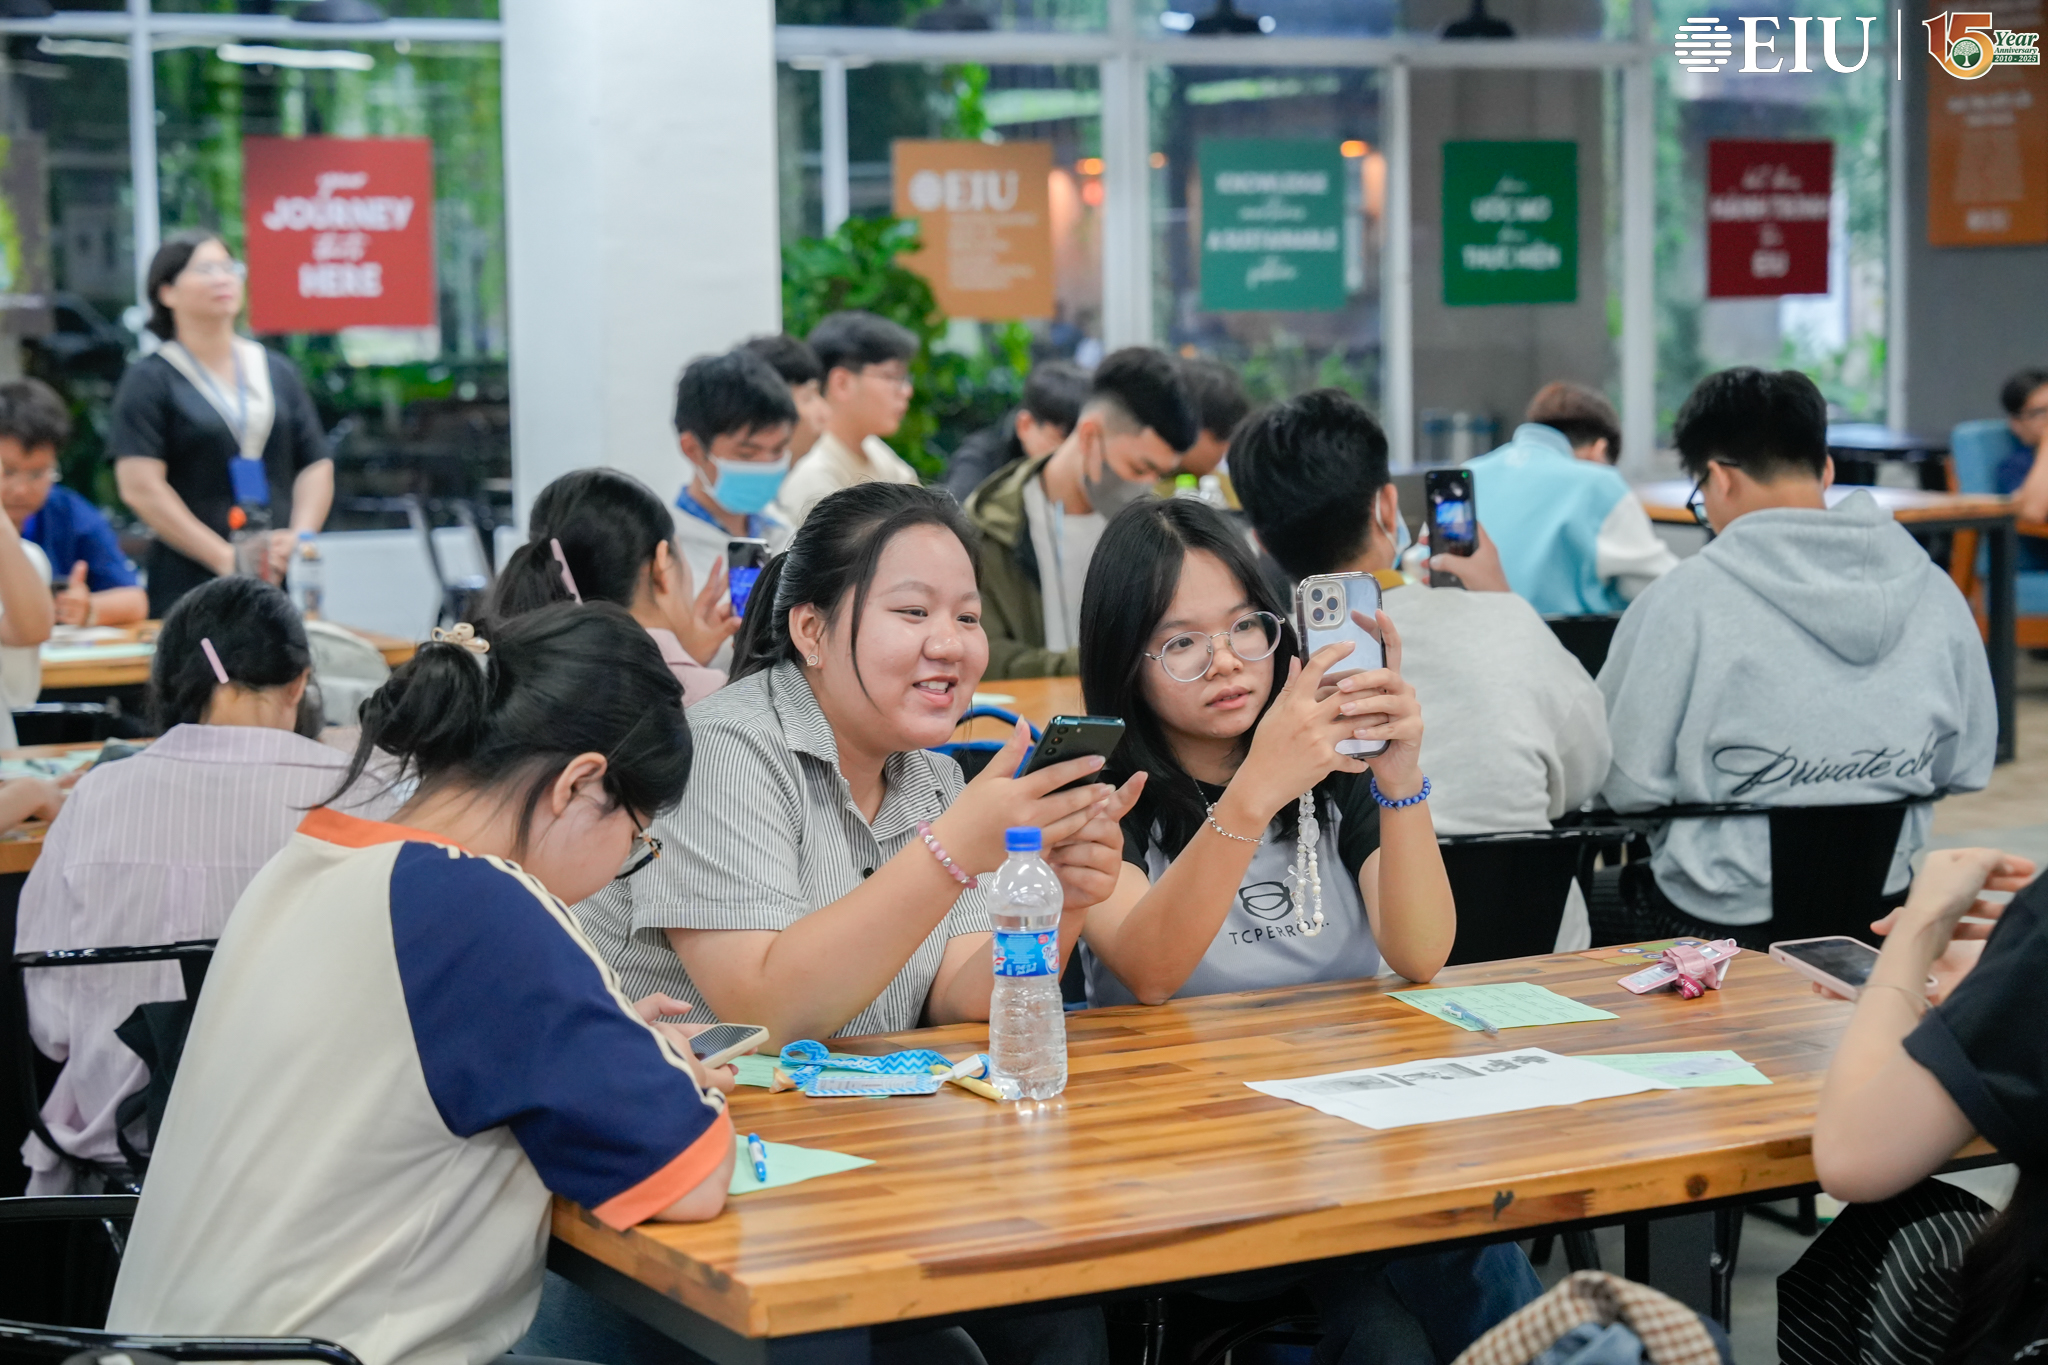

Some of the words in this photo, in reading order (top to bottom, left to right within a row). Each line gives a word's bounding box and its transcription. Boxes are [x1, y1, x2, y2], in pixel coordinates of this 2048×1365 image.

[945, 169, 1019, 213] EIU
[262, 196, 414, 231] JOURNEY
[298, 263, 382, 298] HERE
[1712, 746, 1906, 796] Private
